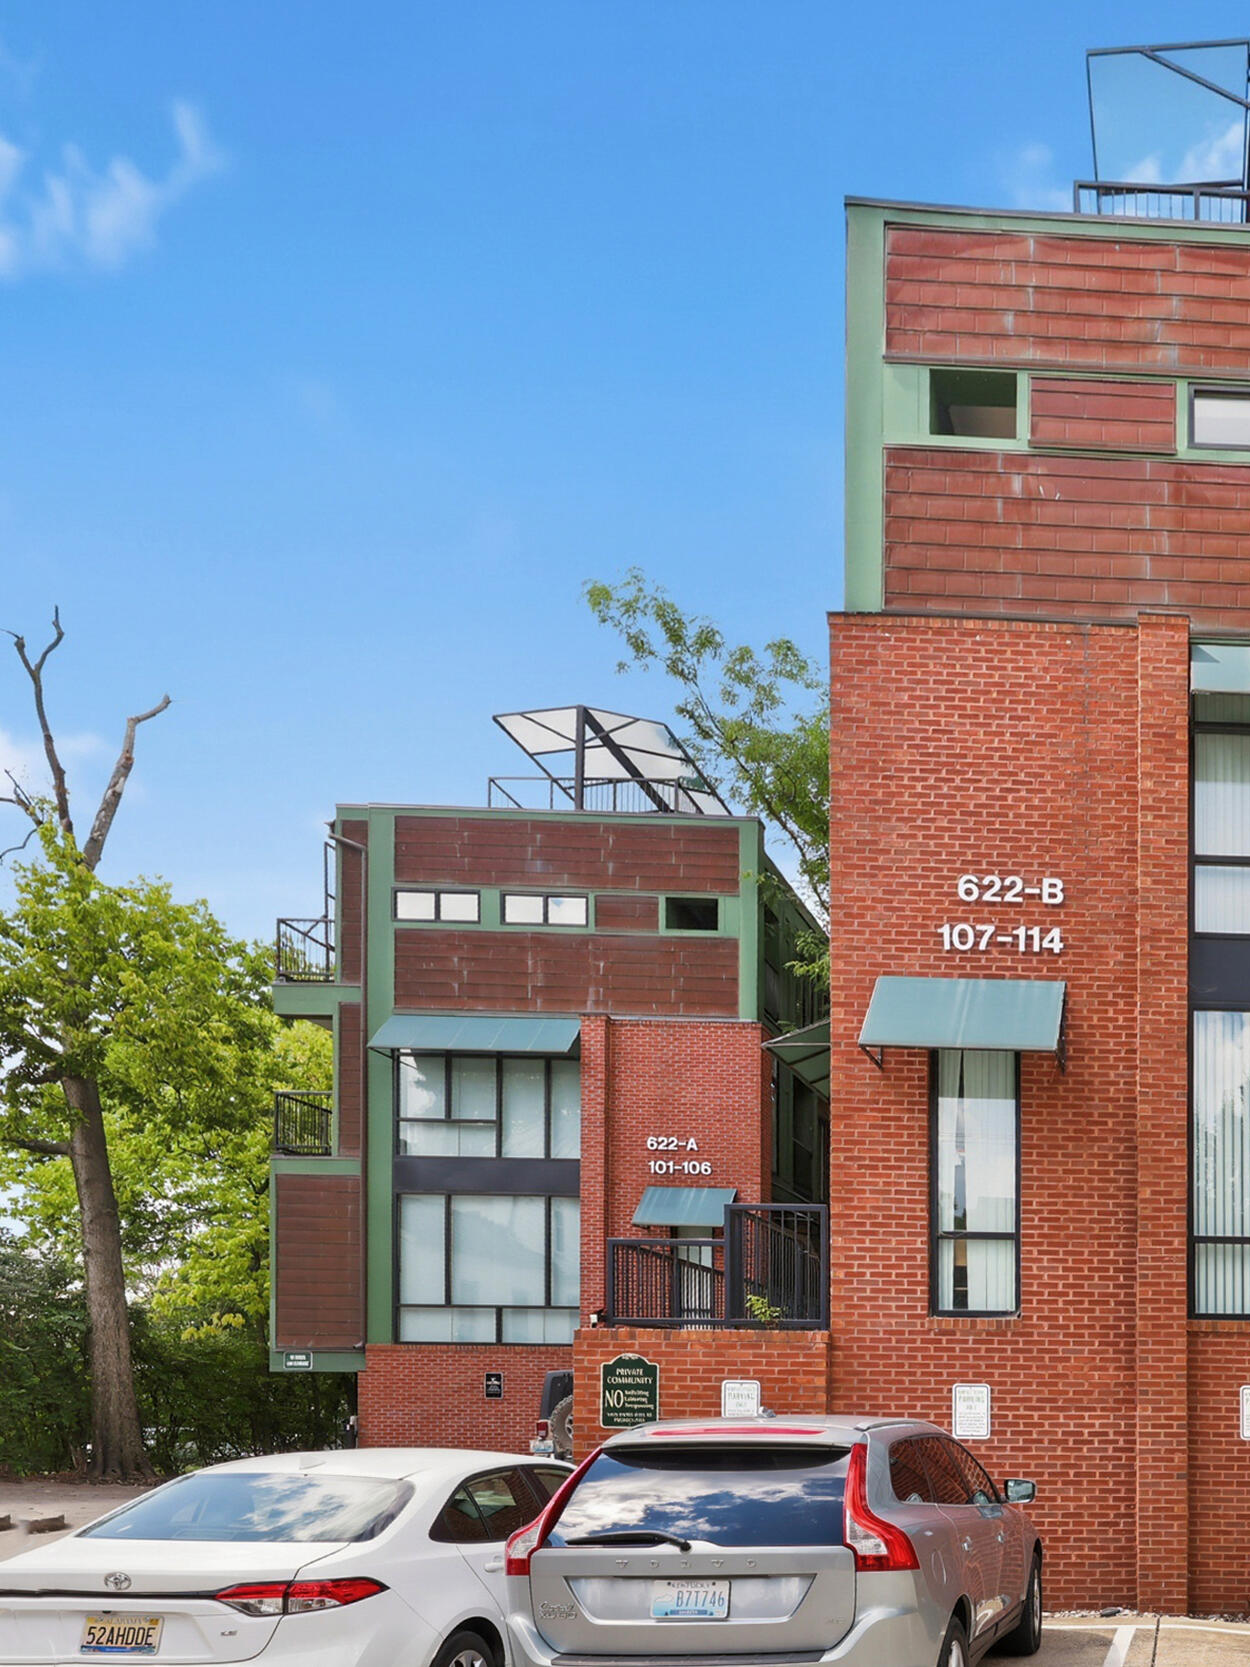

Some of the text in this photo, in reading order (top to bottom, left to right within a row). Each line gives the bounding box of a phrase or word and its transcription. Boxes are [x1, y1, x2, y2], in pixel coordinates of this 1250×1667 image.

[957, 874, 1064, 905] 622-B
[937, 923, 1064, 954] 107-114
[646, 1136, 699, 1151] 622-A
[648, 1160, 712, 1175] 101-106
[616, 1368, 644, 1376] PRIVATE
[606, 1376, 653, 1384] COMMUNITY
[605, 1389, 624, 1408] NO
